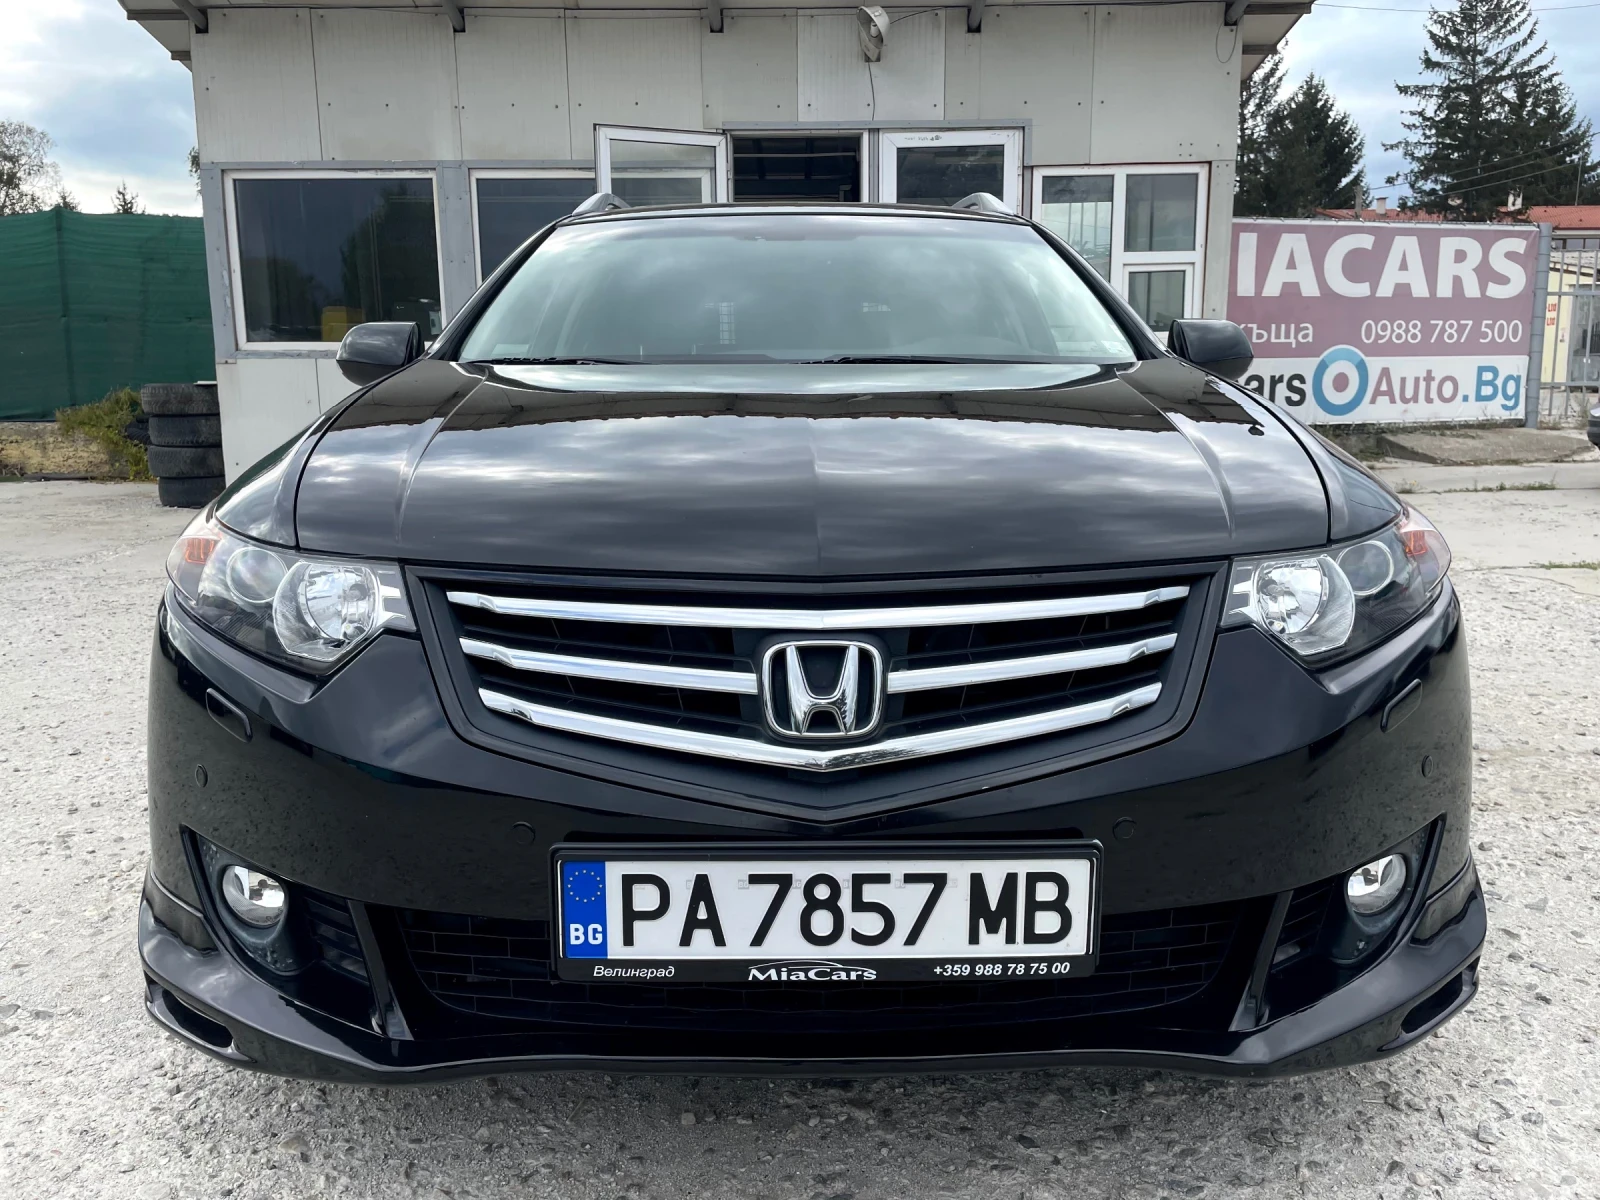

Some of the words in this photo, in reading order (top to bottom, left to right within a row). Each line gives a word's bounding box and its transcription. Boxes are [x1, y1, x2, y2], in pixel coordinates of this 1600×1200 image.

[1236, 232, 1527, 299] IACARS
[1239, 323, 1314, 348] ъща
[1361, 320, 1422, 344] 0988
[1430, 320, 1472, 344] 787
[1479, 320, 1523, 344] 500
[621, 873, 727, 947] PA
[748, 872, 948, 947] 7857
[968, 871, 1073, 946] MB
[569, 923, 603, 945] BG
[592, 965, 675, 979] Велинград
[748, 967, 877, 981] MiaCars
[933, 963, 970, 977] +359
[974, 963, 1002, 976] 988
[1006, 963, 1025, 976] 78
[1029, 962, 1048, 975] 75
[1051, 962, 1071, 974] 00
